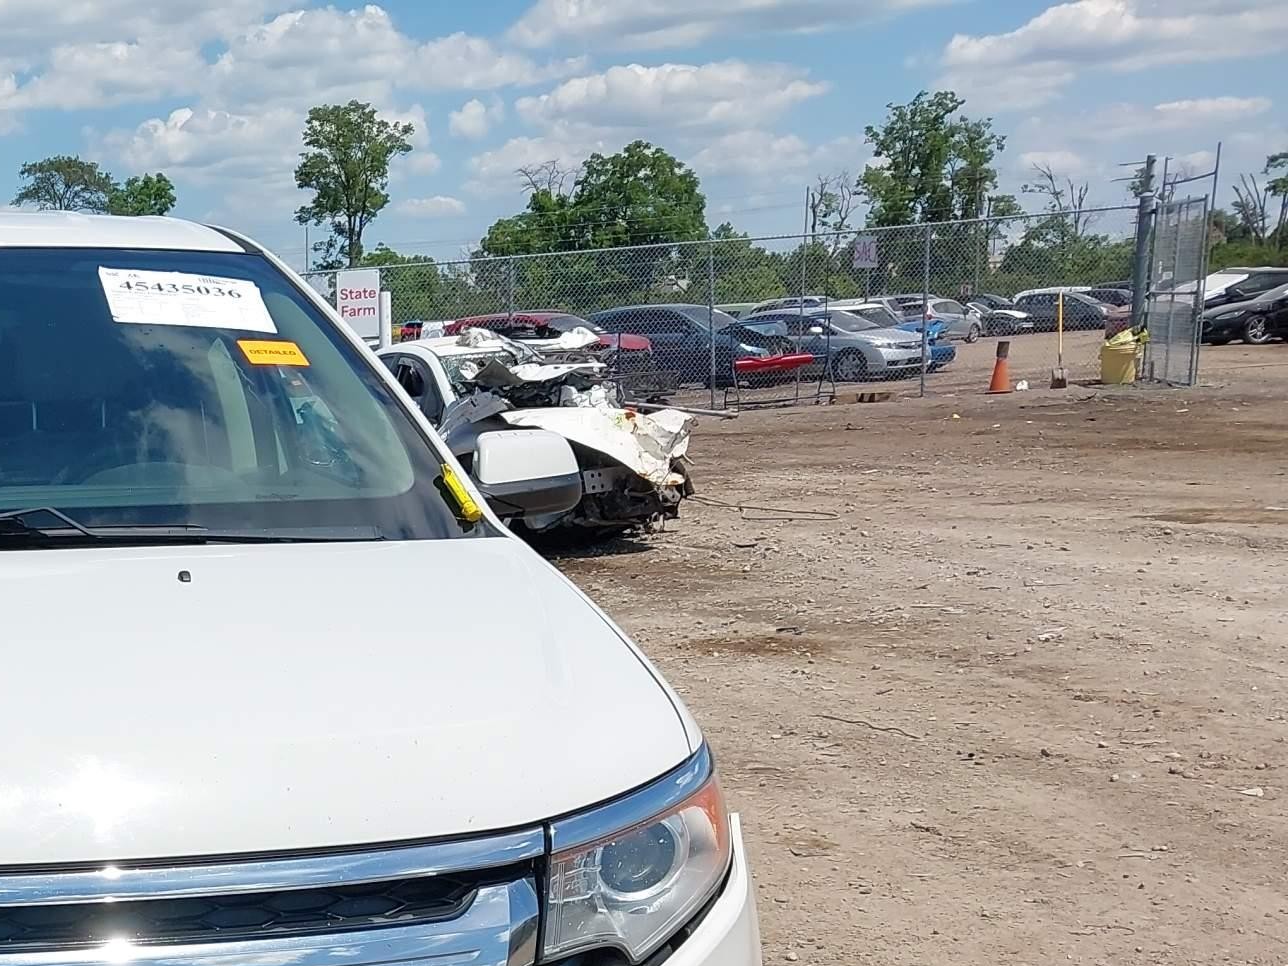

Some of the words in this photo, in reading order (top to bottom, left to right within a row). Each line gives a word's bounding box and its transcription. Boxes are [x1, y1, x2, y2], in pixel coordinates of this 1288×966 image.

[119, 280, 243, 299] 45435036
[340, 288, 376, 300] State
[341, 305, 376, 318] Farm
